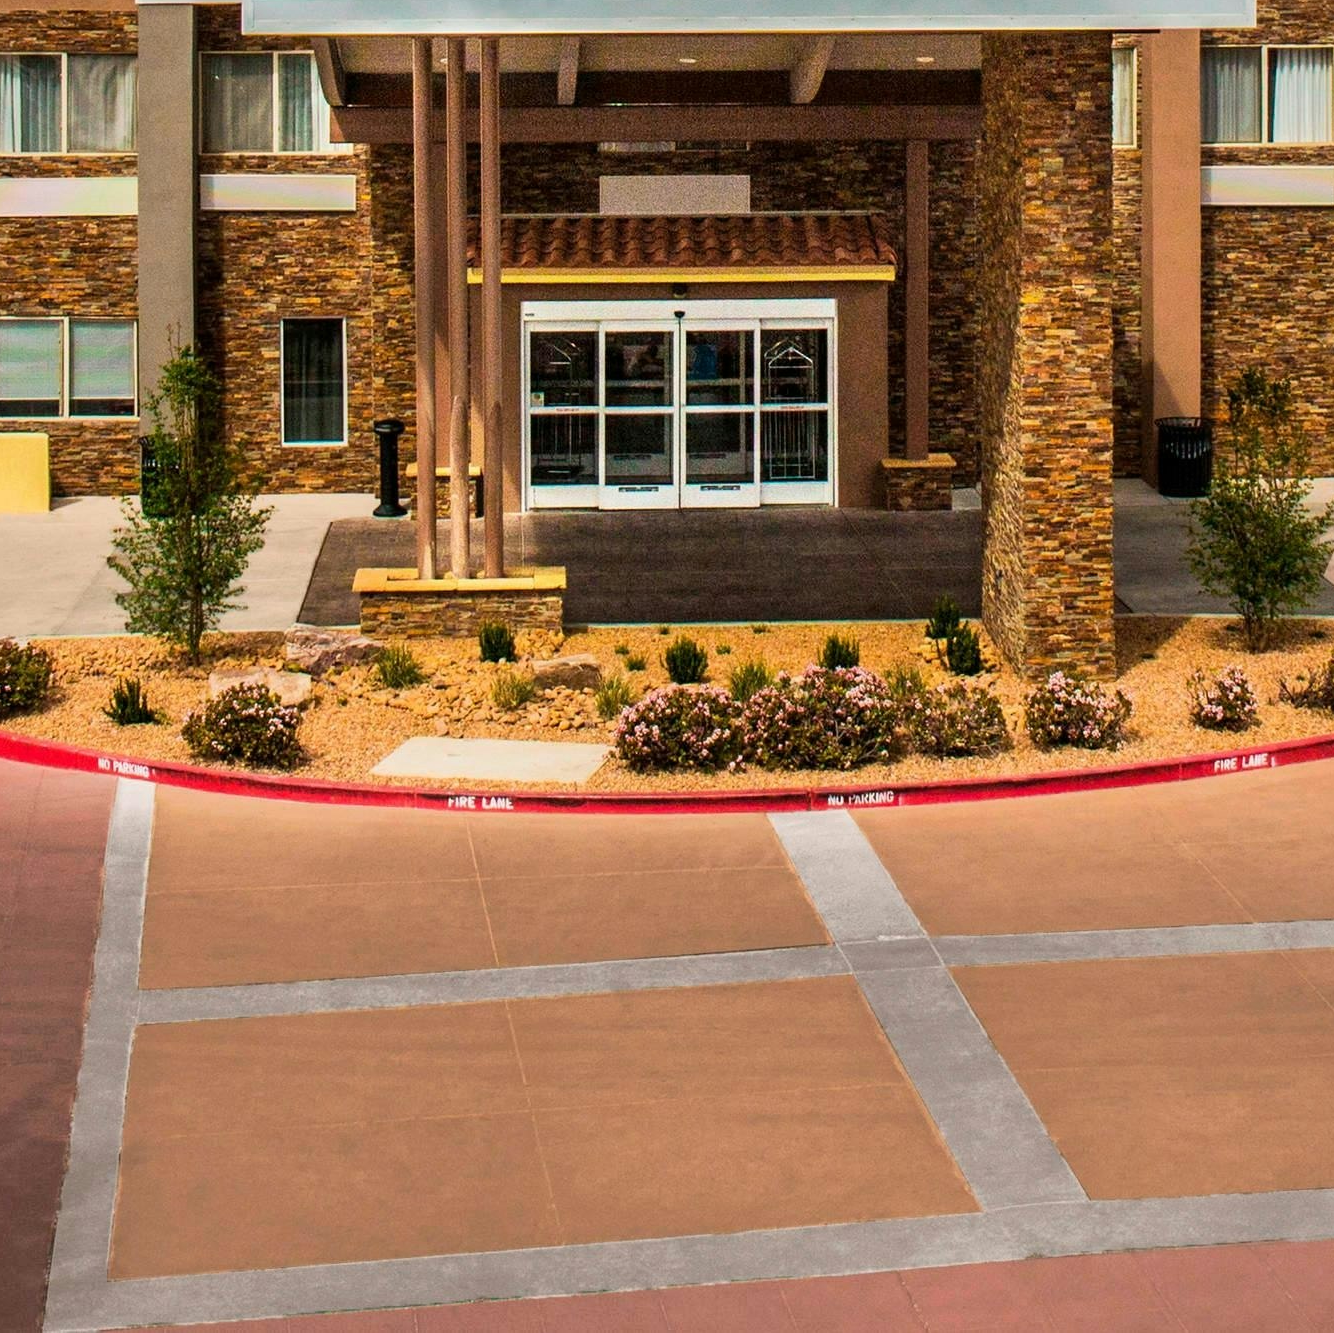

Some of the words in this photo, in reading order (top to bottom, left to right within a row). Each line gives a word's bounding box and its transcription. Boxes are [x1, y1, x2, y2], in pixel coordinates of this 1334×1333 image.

[98, 757, 111, 770] NO
[113, 760, 150, 778] PARKING
[1214, 757, 1237, 772] FIRE
[1242, 753, 1268, 769] LANE
[448, 796, 476, 810] FIRE
[482, 796, 514, 810] LANE
[848, 785, 895, 806] PARKING
